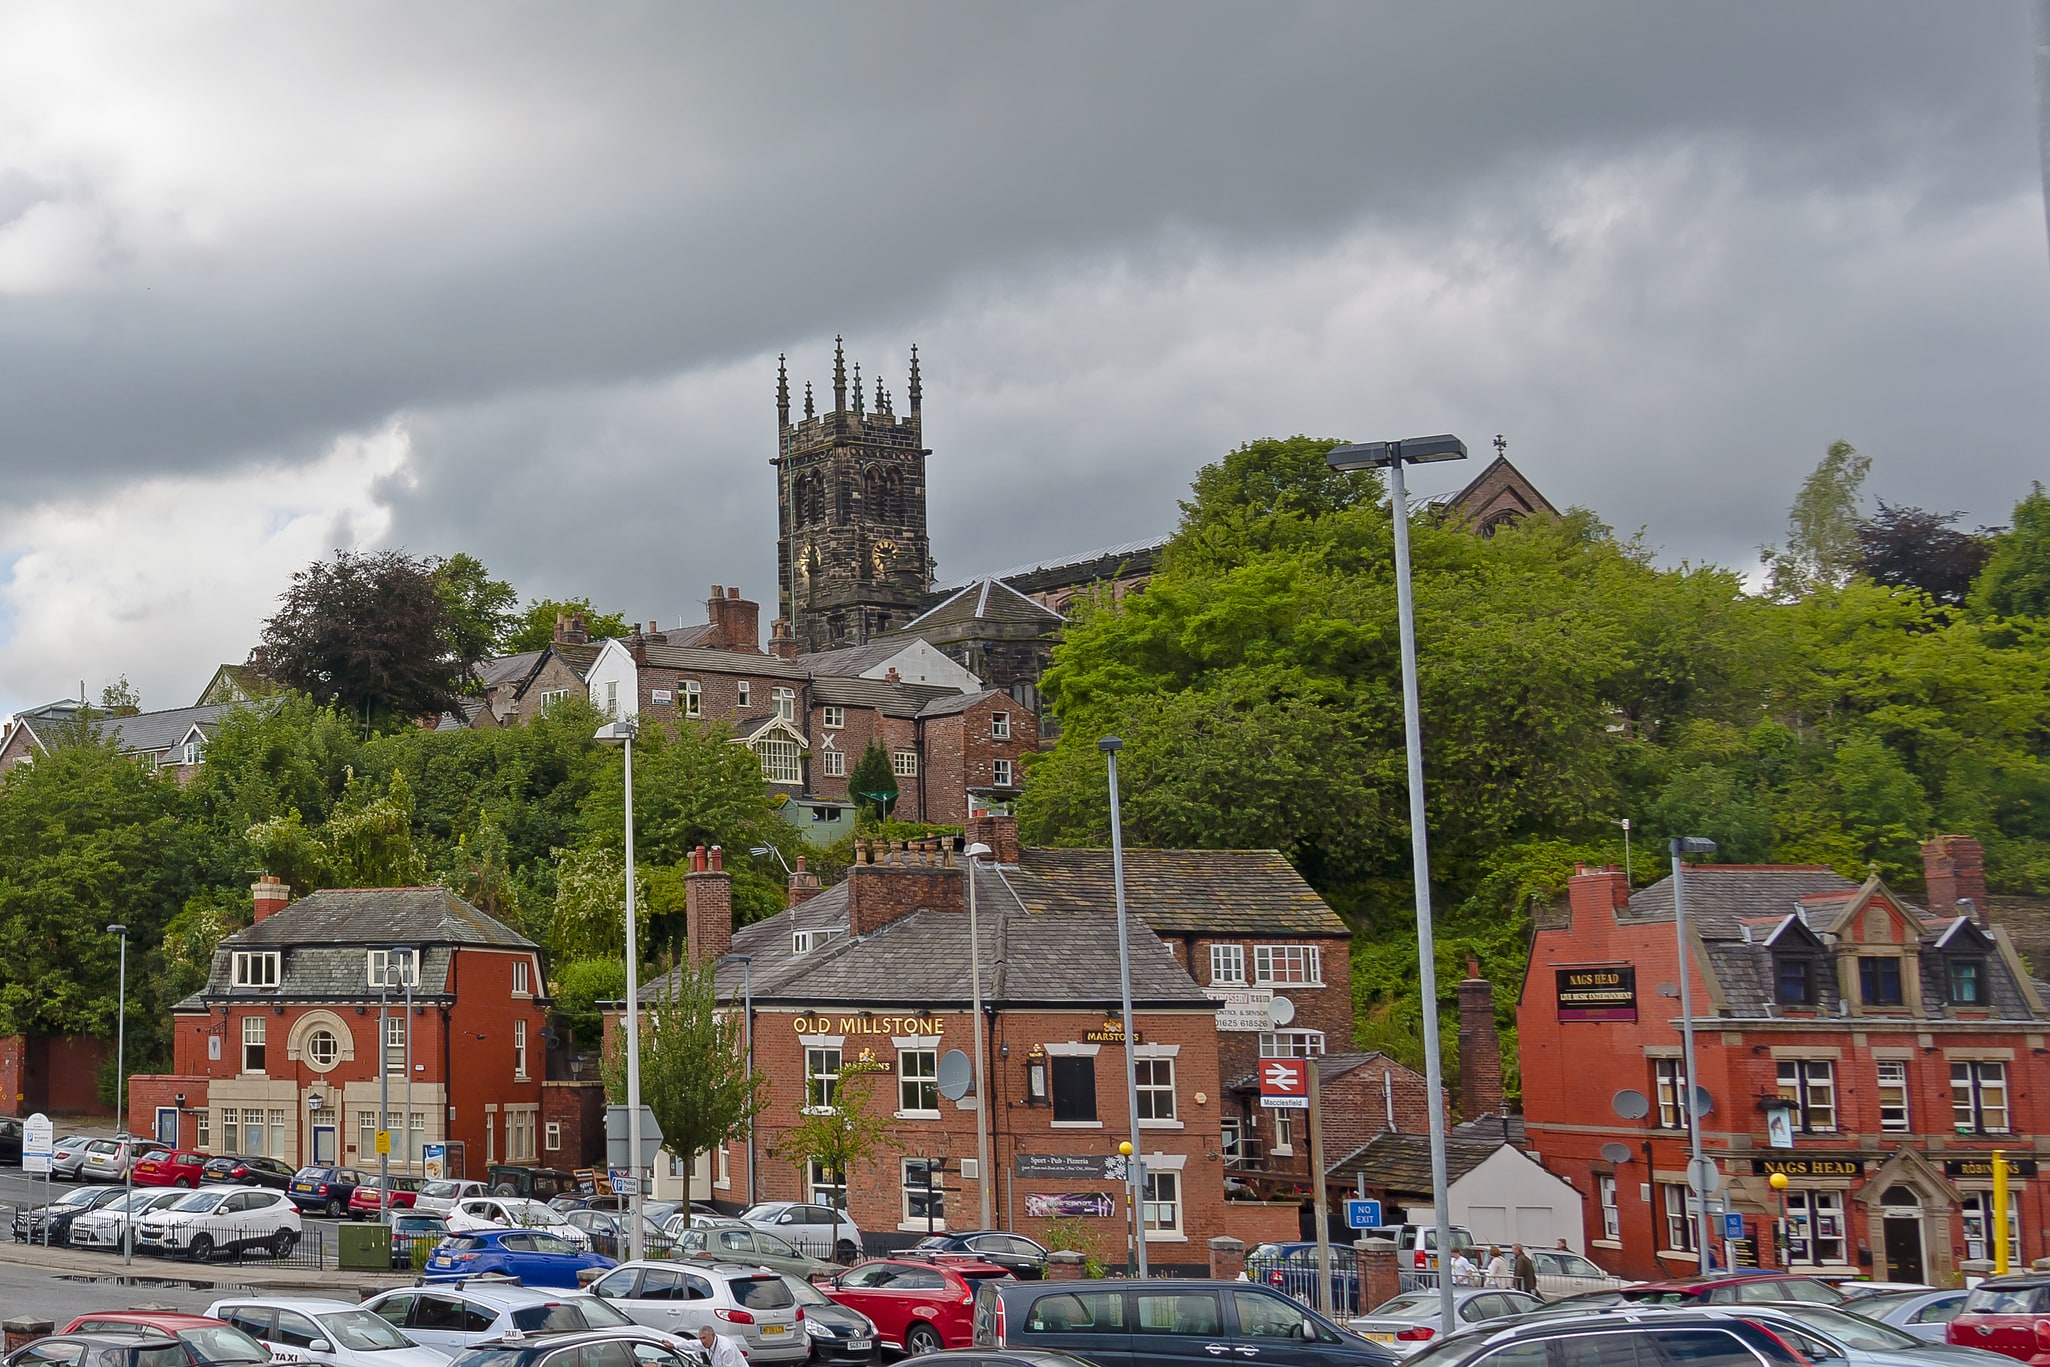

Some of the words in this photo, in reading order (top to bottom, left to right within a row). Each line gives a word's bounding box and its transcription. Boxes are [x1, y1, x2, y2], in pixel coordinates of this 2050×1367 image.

[1569, 974, 1593, 985] NAGS
[1594, 973, 1619, 985] HEAD
[793, 1017, 831, 1034] OLD
[839, 1017, 945, 1035] MILLSTONE
[1240, 1020, 1268, 1028] 618526
[1087, 1032, 1139, 1042] MARSTO'S
[1263, 1098, 1302, 1107] Macclesfield
[1030, 1156, 1047, 1165] Sport
[1050, 1156, 1062, 1165] Pub
[1066, 1157, 1089, 1165] Pizzeria
[1764, 1161, 1807, 1173] NAGS
[1811, 1161, 1857, 1174] HEAD
[1961, 1163, 2020, 1174] ROBINNS
[1357, 1205, 1371, 1214] NO
[1356, 1215, 1374, 1224] EXIT
[505, 1330, 517, 1338] TAXI
[275, 1352, 298, 1362] TAXI
